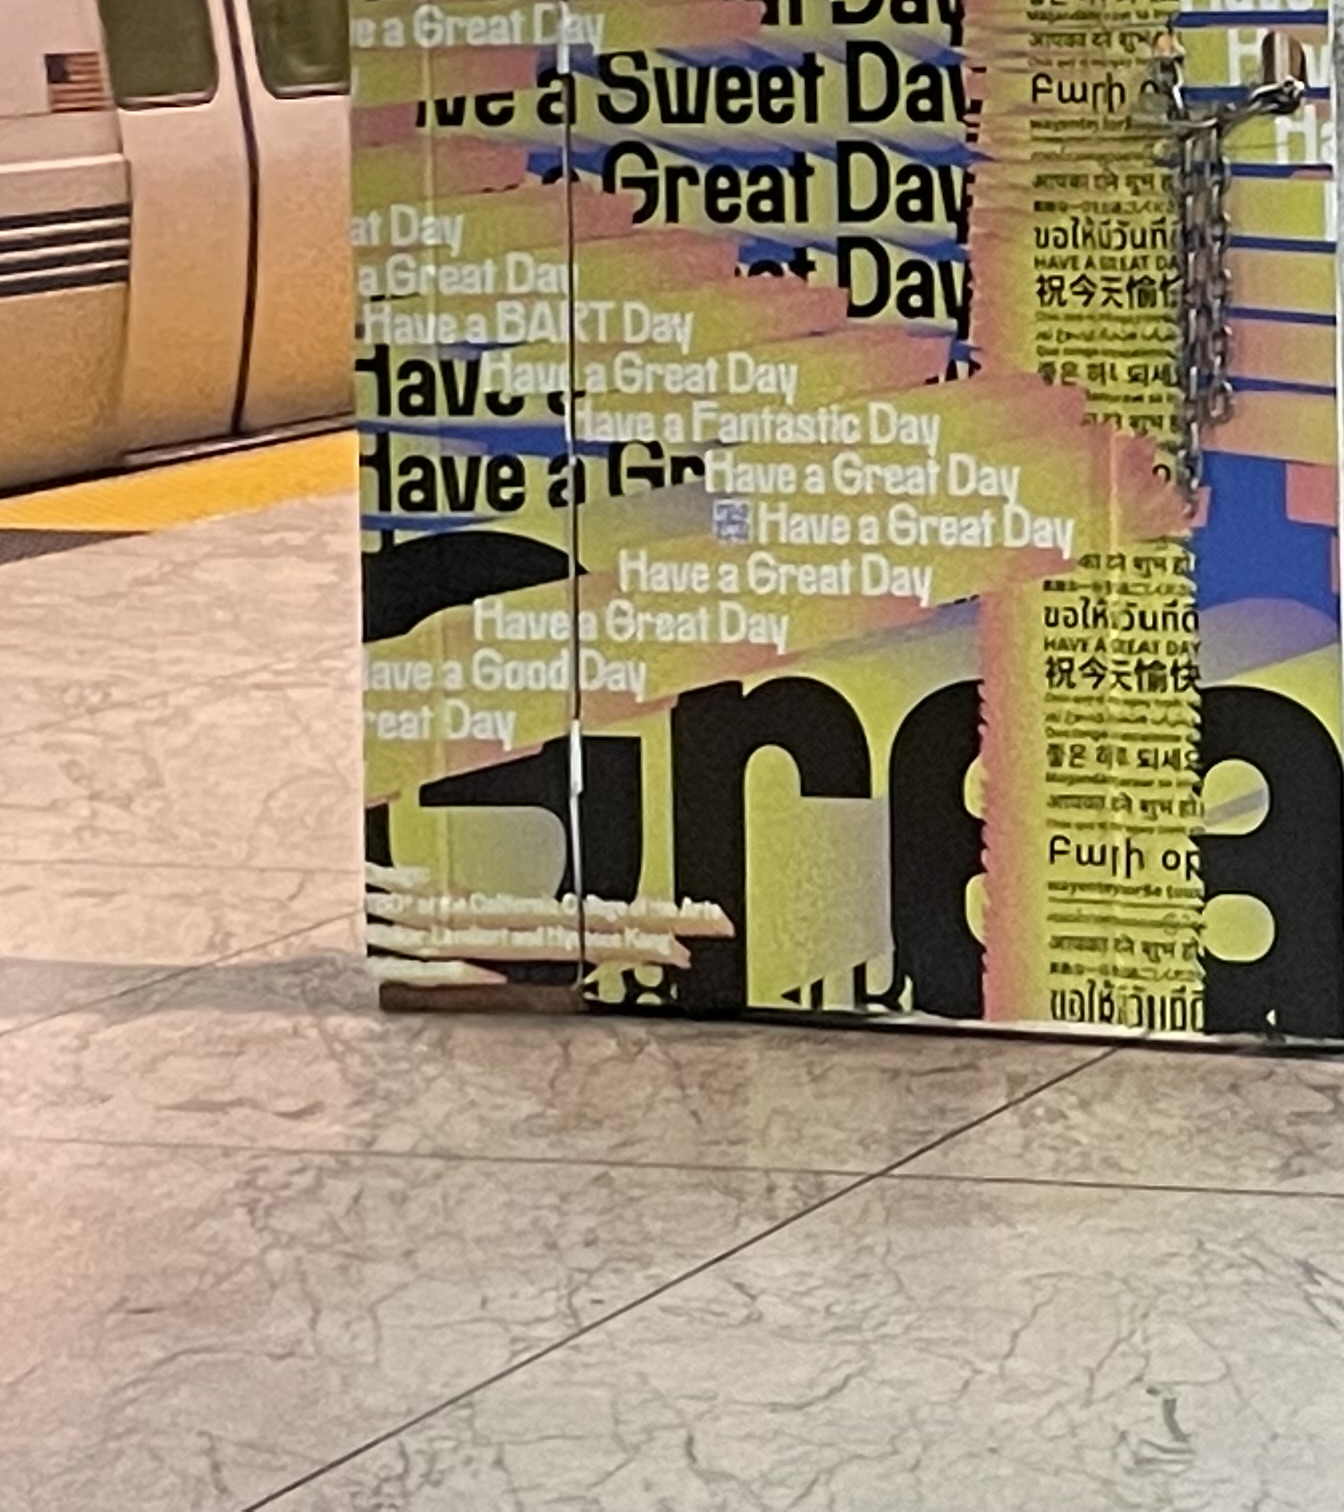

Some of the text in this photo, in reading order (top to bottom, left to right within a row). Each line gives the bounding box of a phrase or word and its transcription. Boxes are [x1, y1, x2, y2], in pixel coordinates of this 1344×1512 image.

[597, 50, 825, 126] Sweet
[364, 300, 695, 351] Have a BART Day
[665, 412, 687, 443] a
[693, 404, 861, 445] Fantastic
[868, 403, 941, 454] Day
[705, 451, 1021, 506] Have a Great Day
